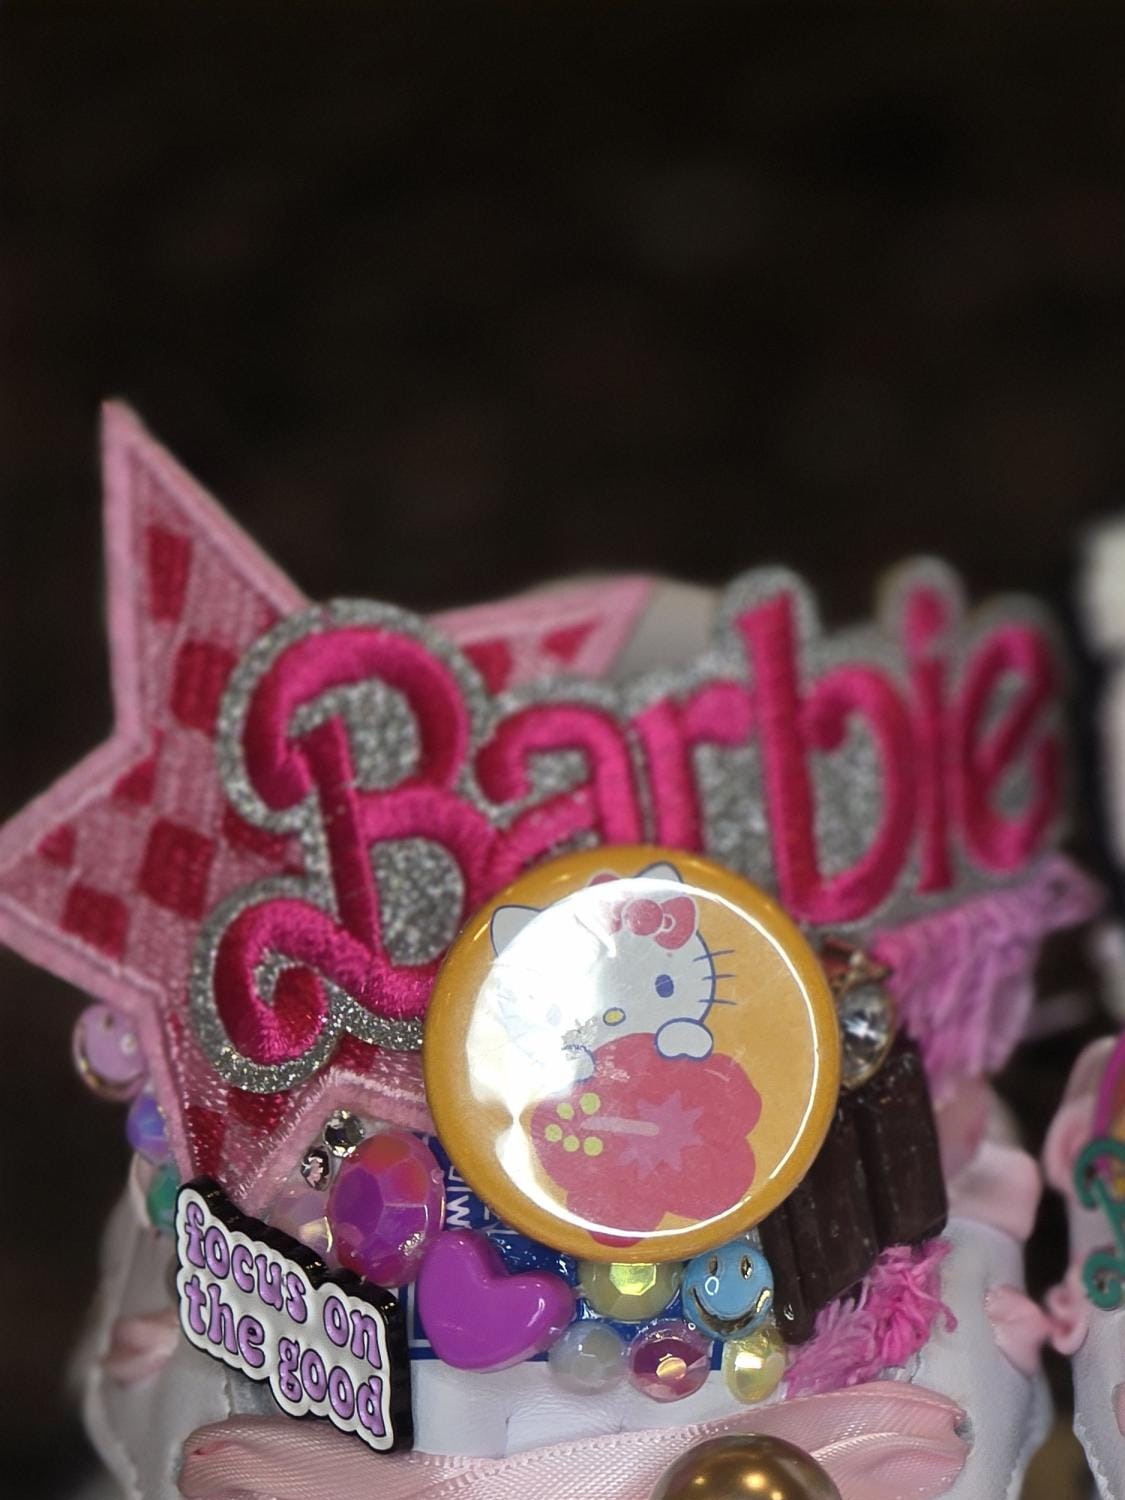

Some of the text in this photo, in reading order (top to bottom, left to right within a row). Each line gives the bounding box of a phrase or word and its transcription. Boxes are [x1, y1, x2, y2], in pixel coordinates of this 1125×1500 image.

[210, 586, 1066, 1066] Barbie
[183, 1274, 387, 1438] the good
[184, 1201, 383, 1370] focus on
